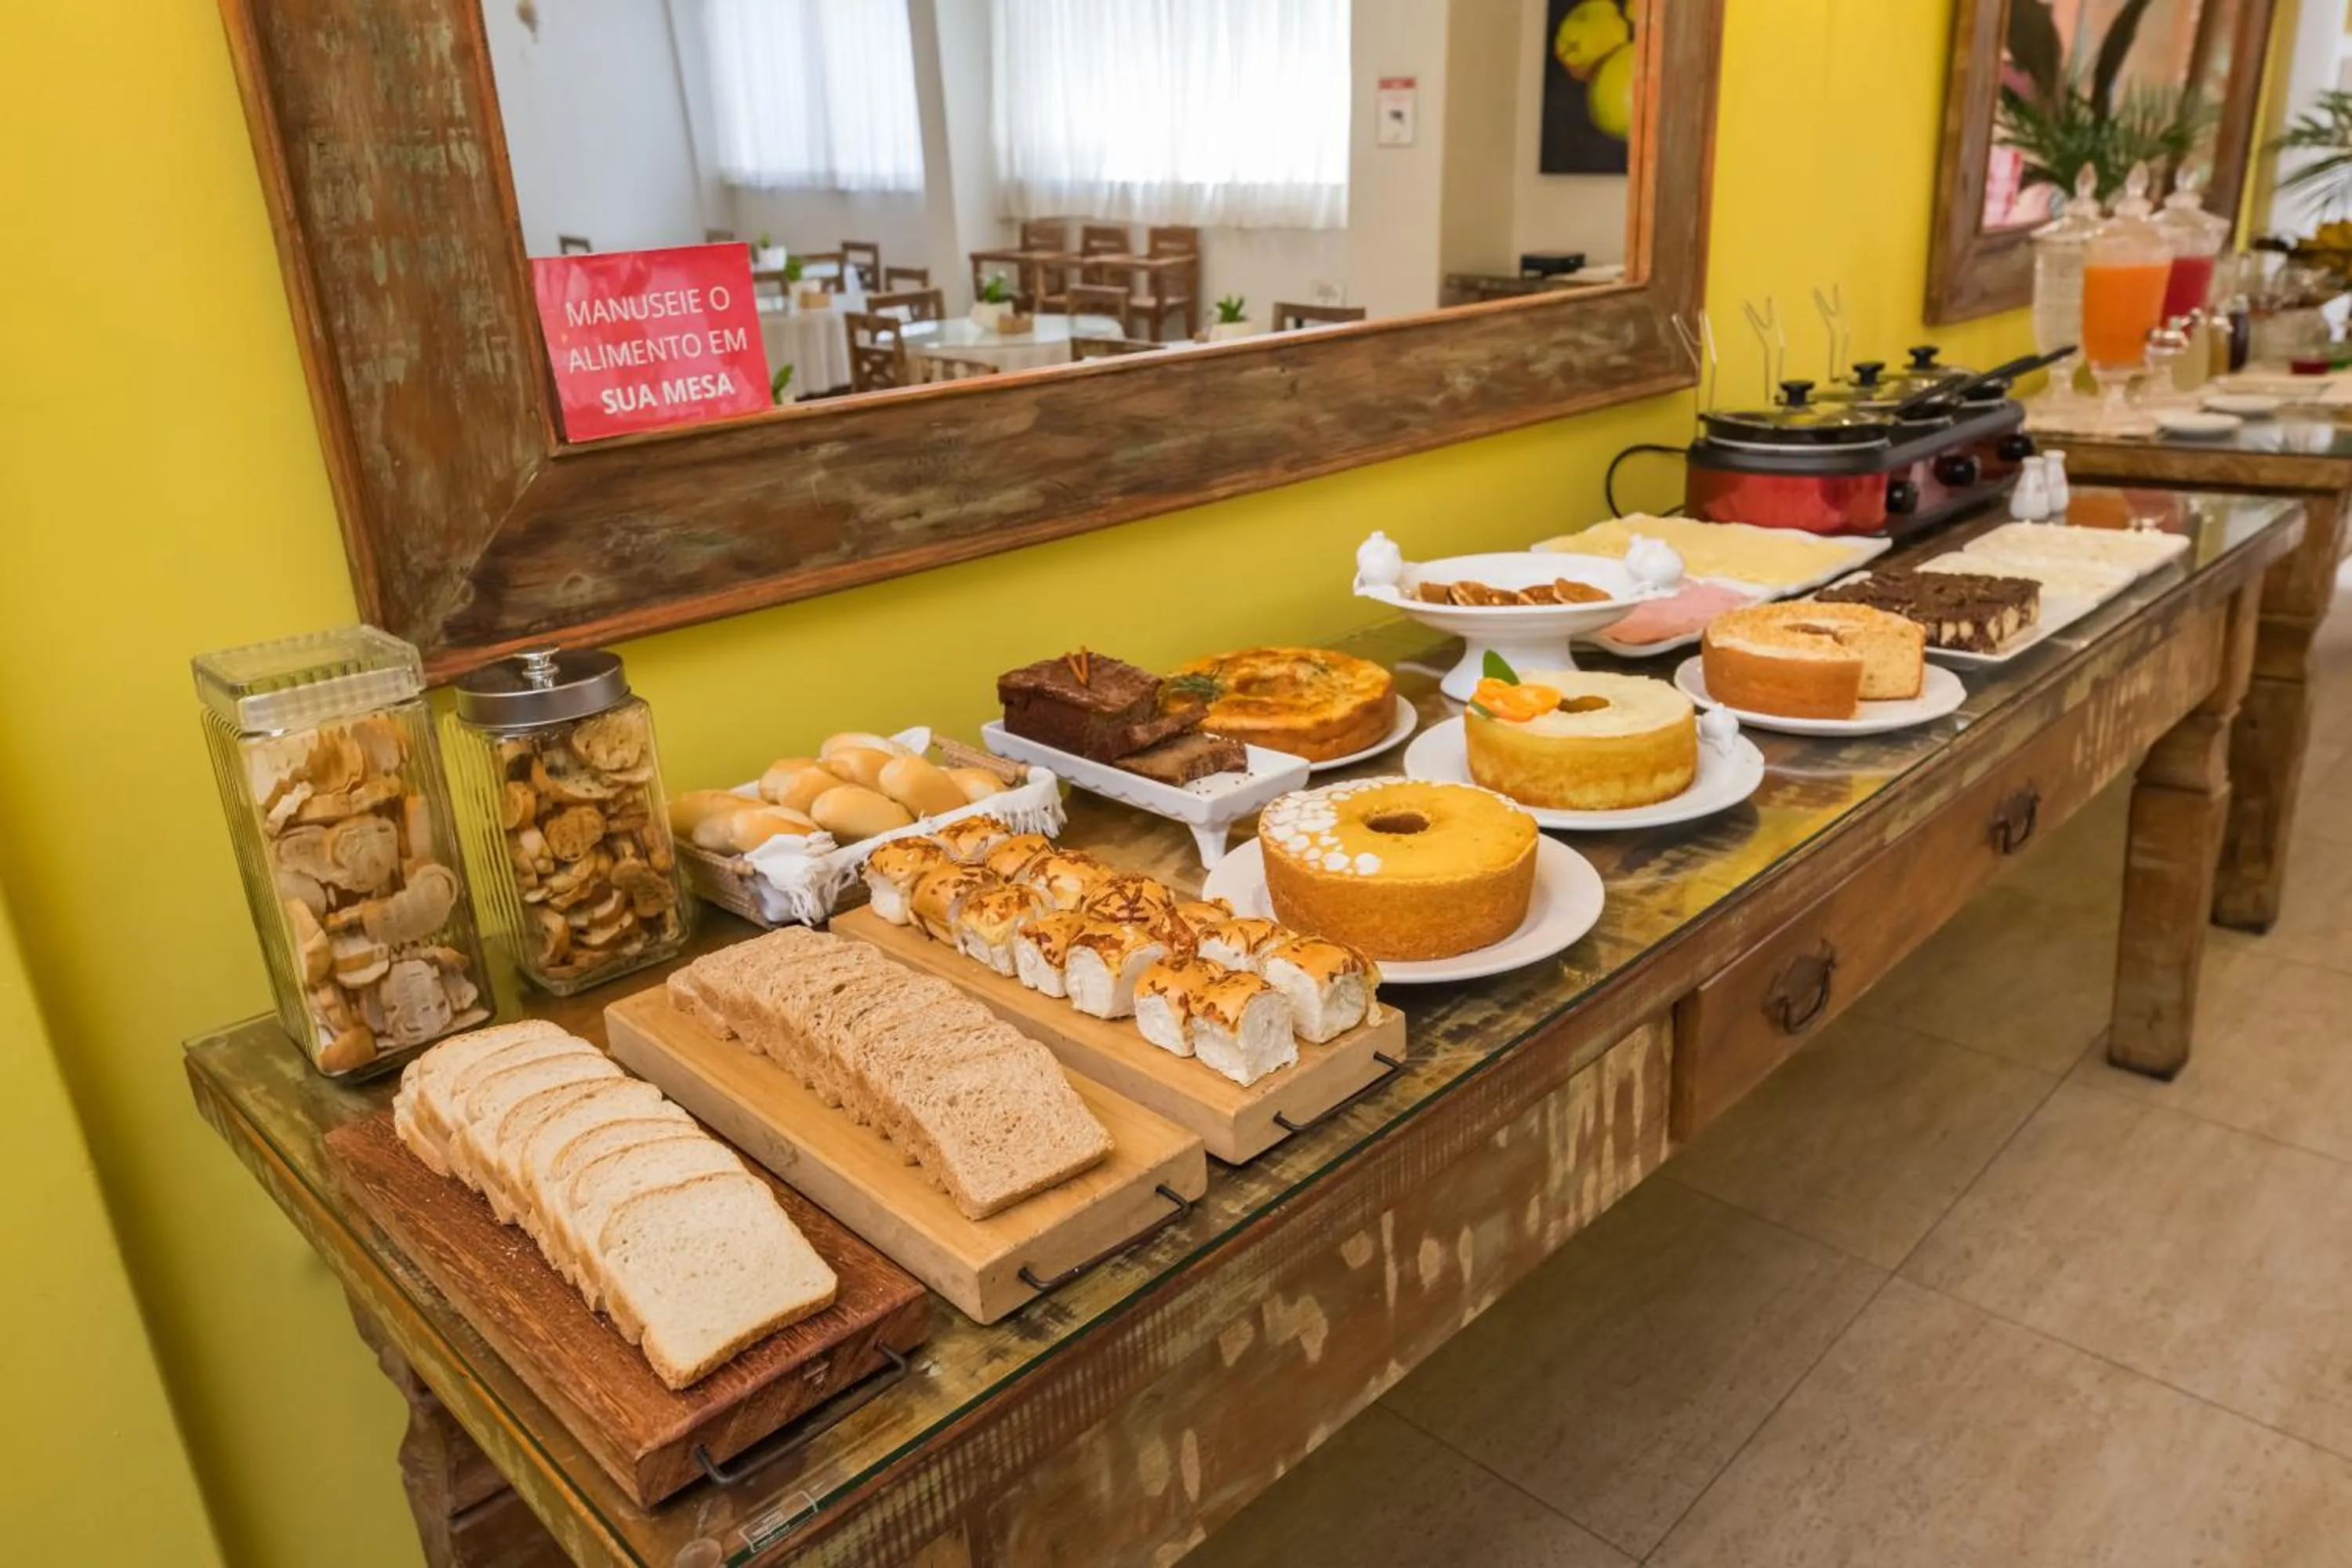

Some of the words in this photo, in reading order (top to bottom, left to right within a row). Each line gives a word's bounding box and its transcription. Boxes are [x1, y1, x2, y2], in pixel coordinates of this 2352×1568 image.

[565, 288, 703, 327] MANUSEIE
[709, 286, 731, 311] O
[569, 332, 702, 374] ALIMENTO
[708, 327, 748, 355] EM
[601, 384, 658, 415] SUA
[662, 372, 736, 405] MESA
